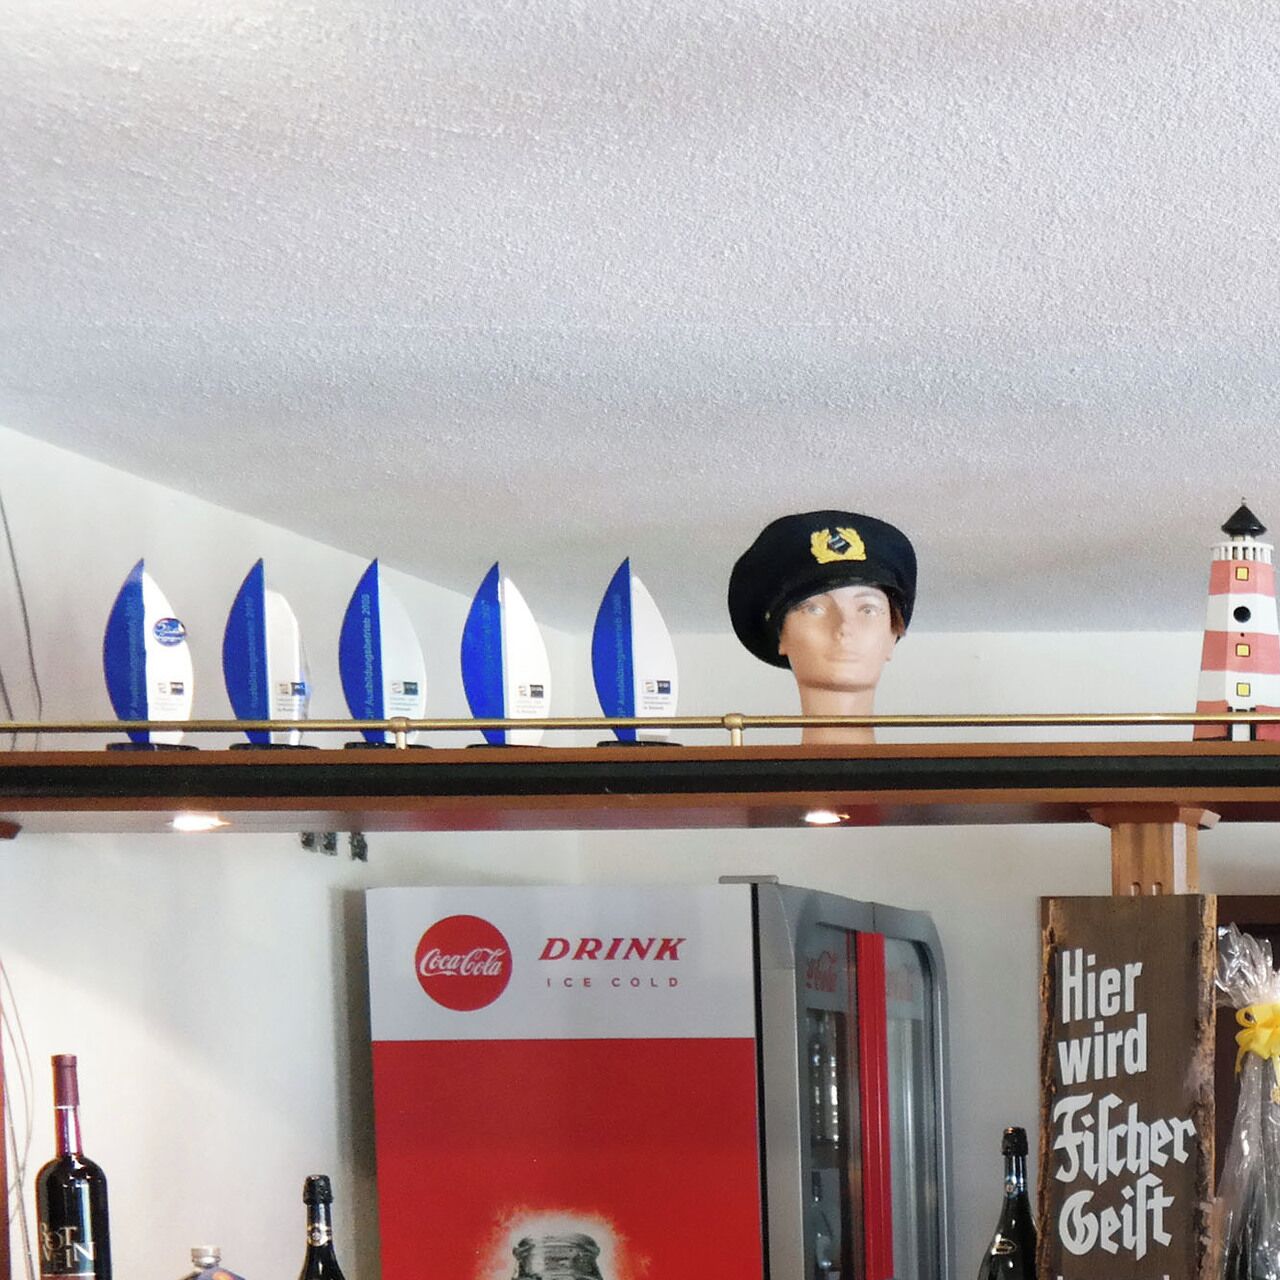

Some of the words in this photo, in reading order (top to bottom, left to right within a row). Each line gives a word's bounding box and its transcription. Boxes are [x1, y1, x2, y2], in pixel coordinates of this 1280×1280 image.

[419, 947, 506, 976] Coca-Cola
[538, 937, 686, 961] DRINK
[546, 977, 592, 988] ICE
[611, 977, 678, 988] COLD
[1062, 948, 1143, 1024] Hier
[1057, 1013, 1147, 1086] wird
